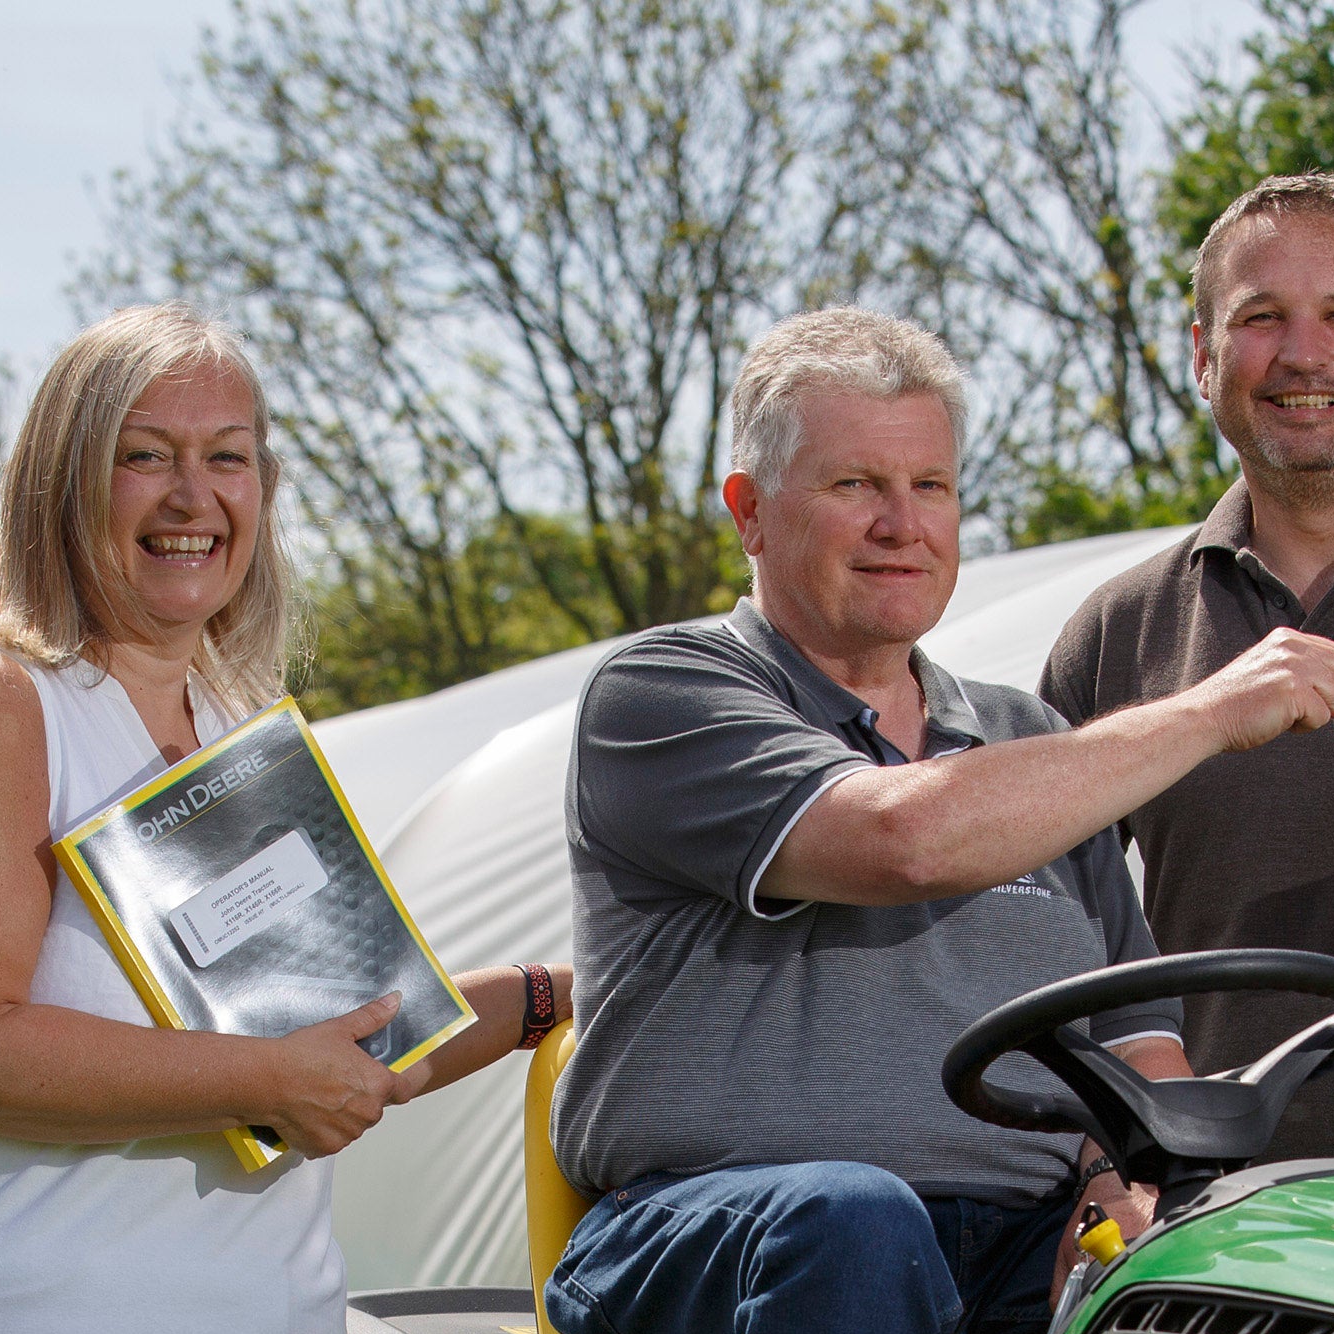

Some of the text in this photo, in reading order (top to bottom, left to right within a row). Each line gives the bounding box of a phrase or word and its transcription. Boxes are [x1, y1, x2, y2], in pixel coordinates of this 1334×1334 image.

[186, 749, 269, 811] DEERE
[210, 864, 274, 909] OPERATOR'S MANUAL
[220, 878, 275, 918] John Deere Tractors
